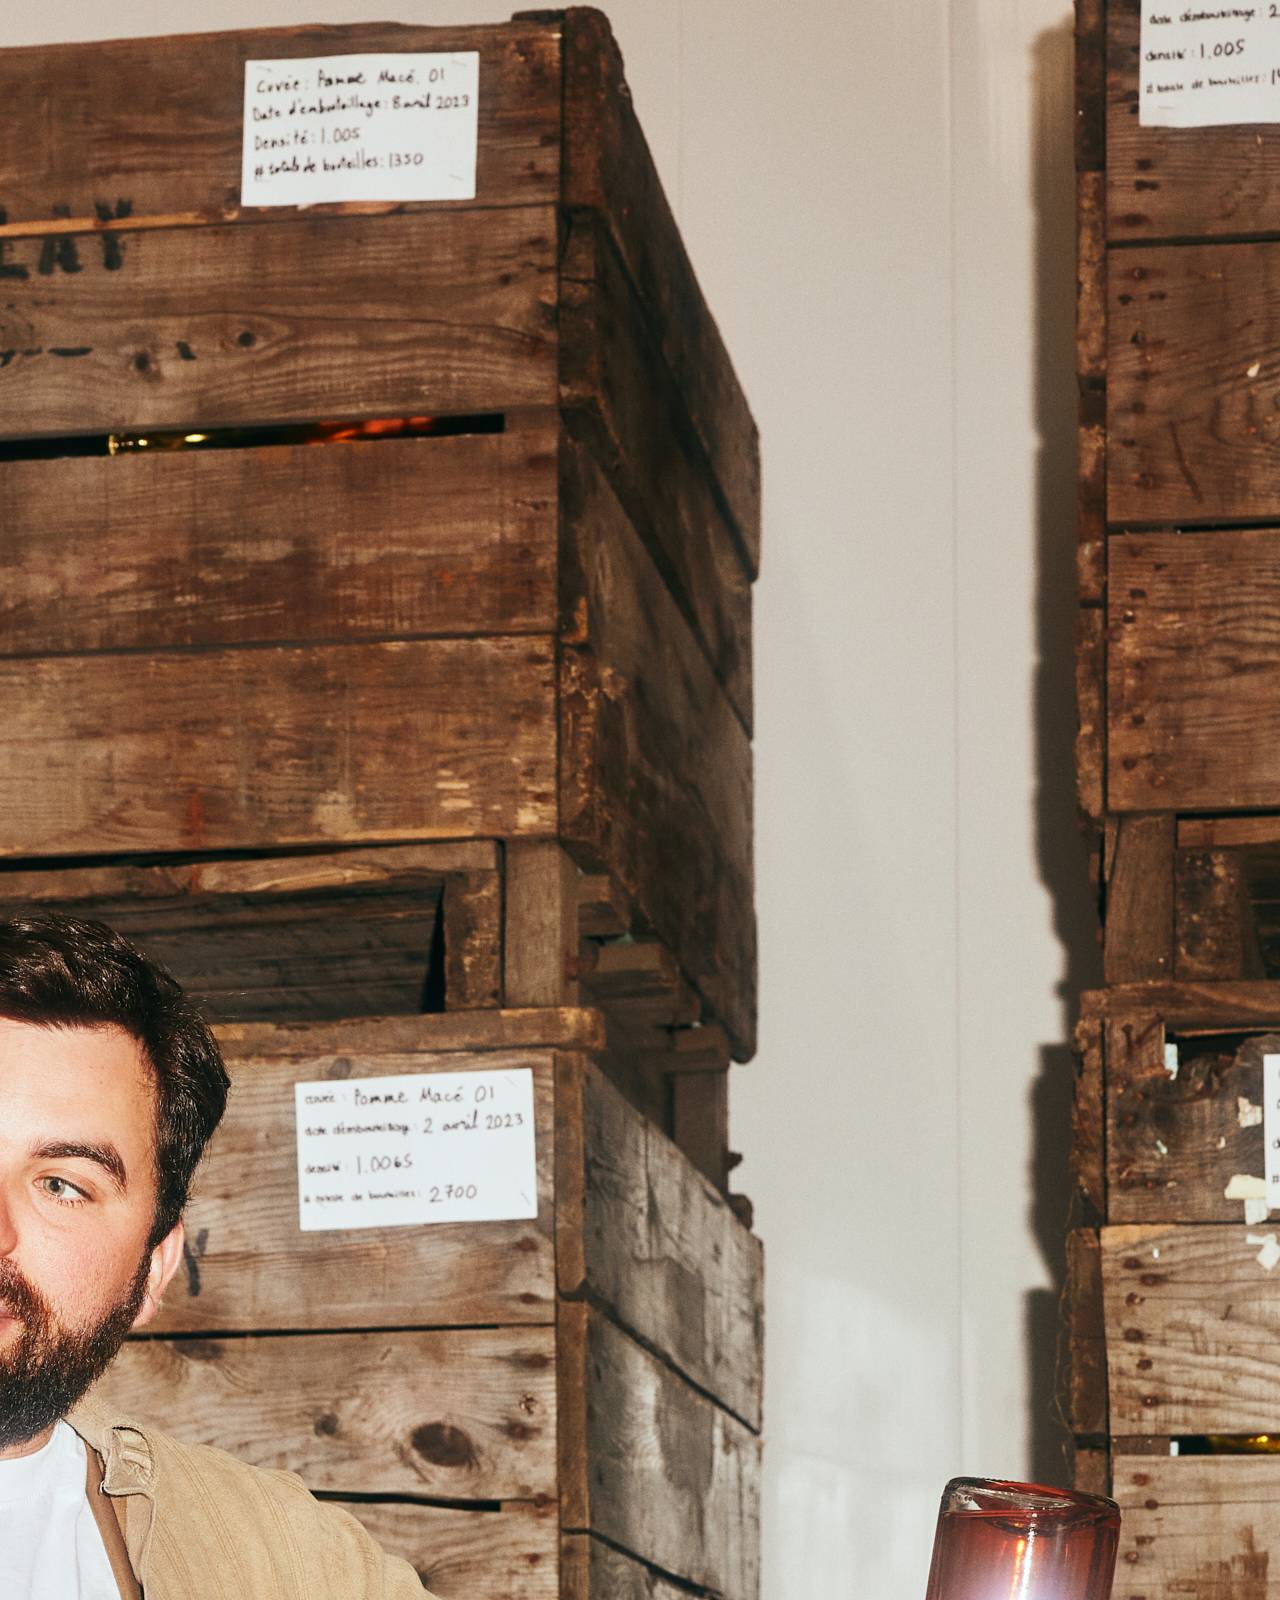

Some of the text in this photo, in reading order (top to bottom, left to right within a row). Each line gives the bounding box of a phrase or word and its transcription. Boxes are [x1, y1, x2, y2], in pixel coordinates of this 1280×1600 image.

[1200, 39, 1244, 59] 1.005
[429, 68, 445, 83] 01
[253, 107, 281, 122] Date
[321, 127, 360, 144] 1.005
[389, 152, 423, 168] 1350
[355, 1088, 408, 1105] Pomme
[420, 1086, 464, 1103] Macé
[475, 1085, 494, 1103] 01
[423, 1117, 433, 1134] 2
[442, 1109, 479, 1131] avril
[486, 1112, 524, 1130] 2023
[357, 1153, 413, 1175] 1.0065
[429, 1184, 477, 1203] 2700
